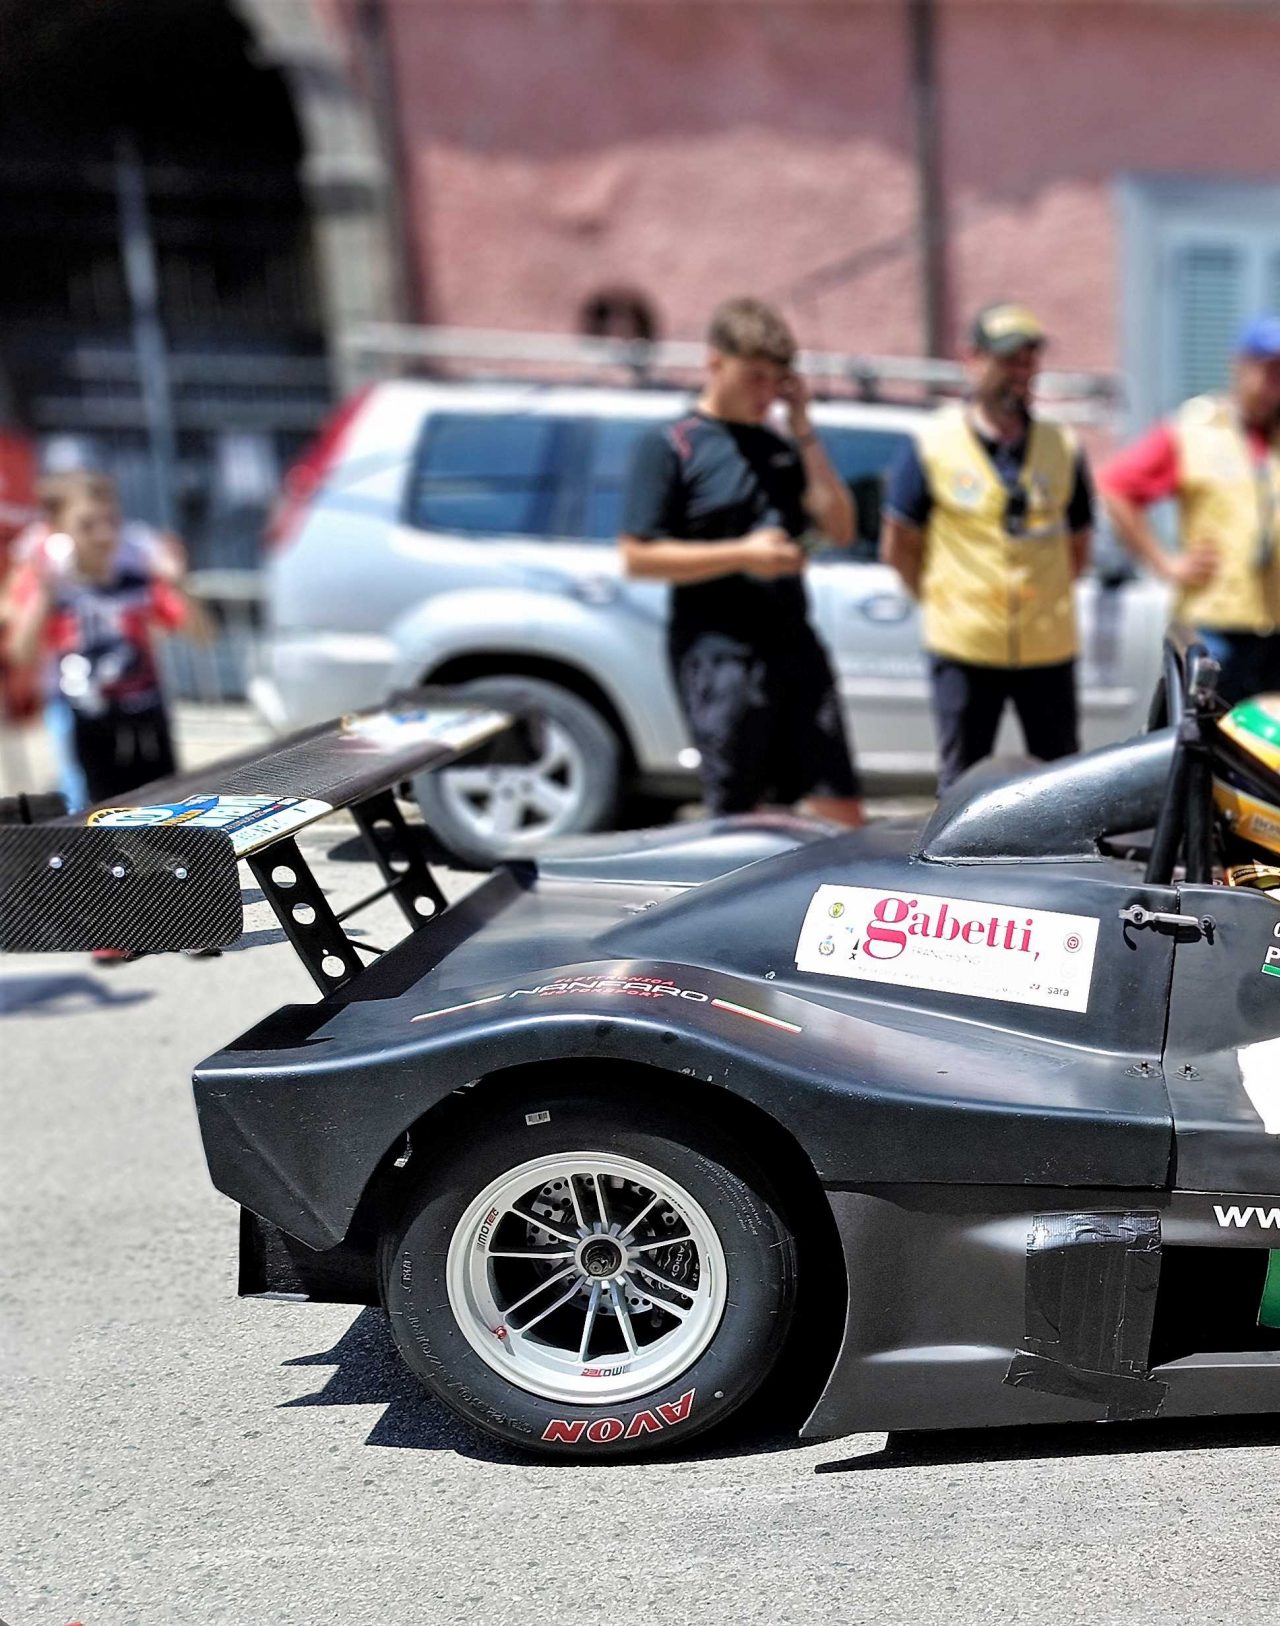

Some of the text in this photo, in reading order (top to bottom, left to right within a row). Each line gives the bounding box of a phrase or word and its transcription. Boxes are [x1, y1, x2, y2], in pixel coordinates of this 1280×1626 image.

[508, 980, 709, 1003] NANFARO
[1047, 985, 1070, 997] sara
[540, 1388, 695, 1443] AVON
